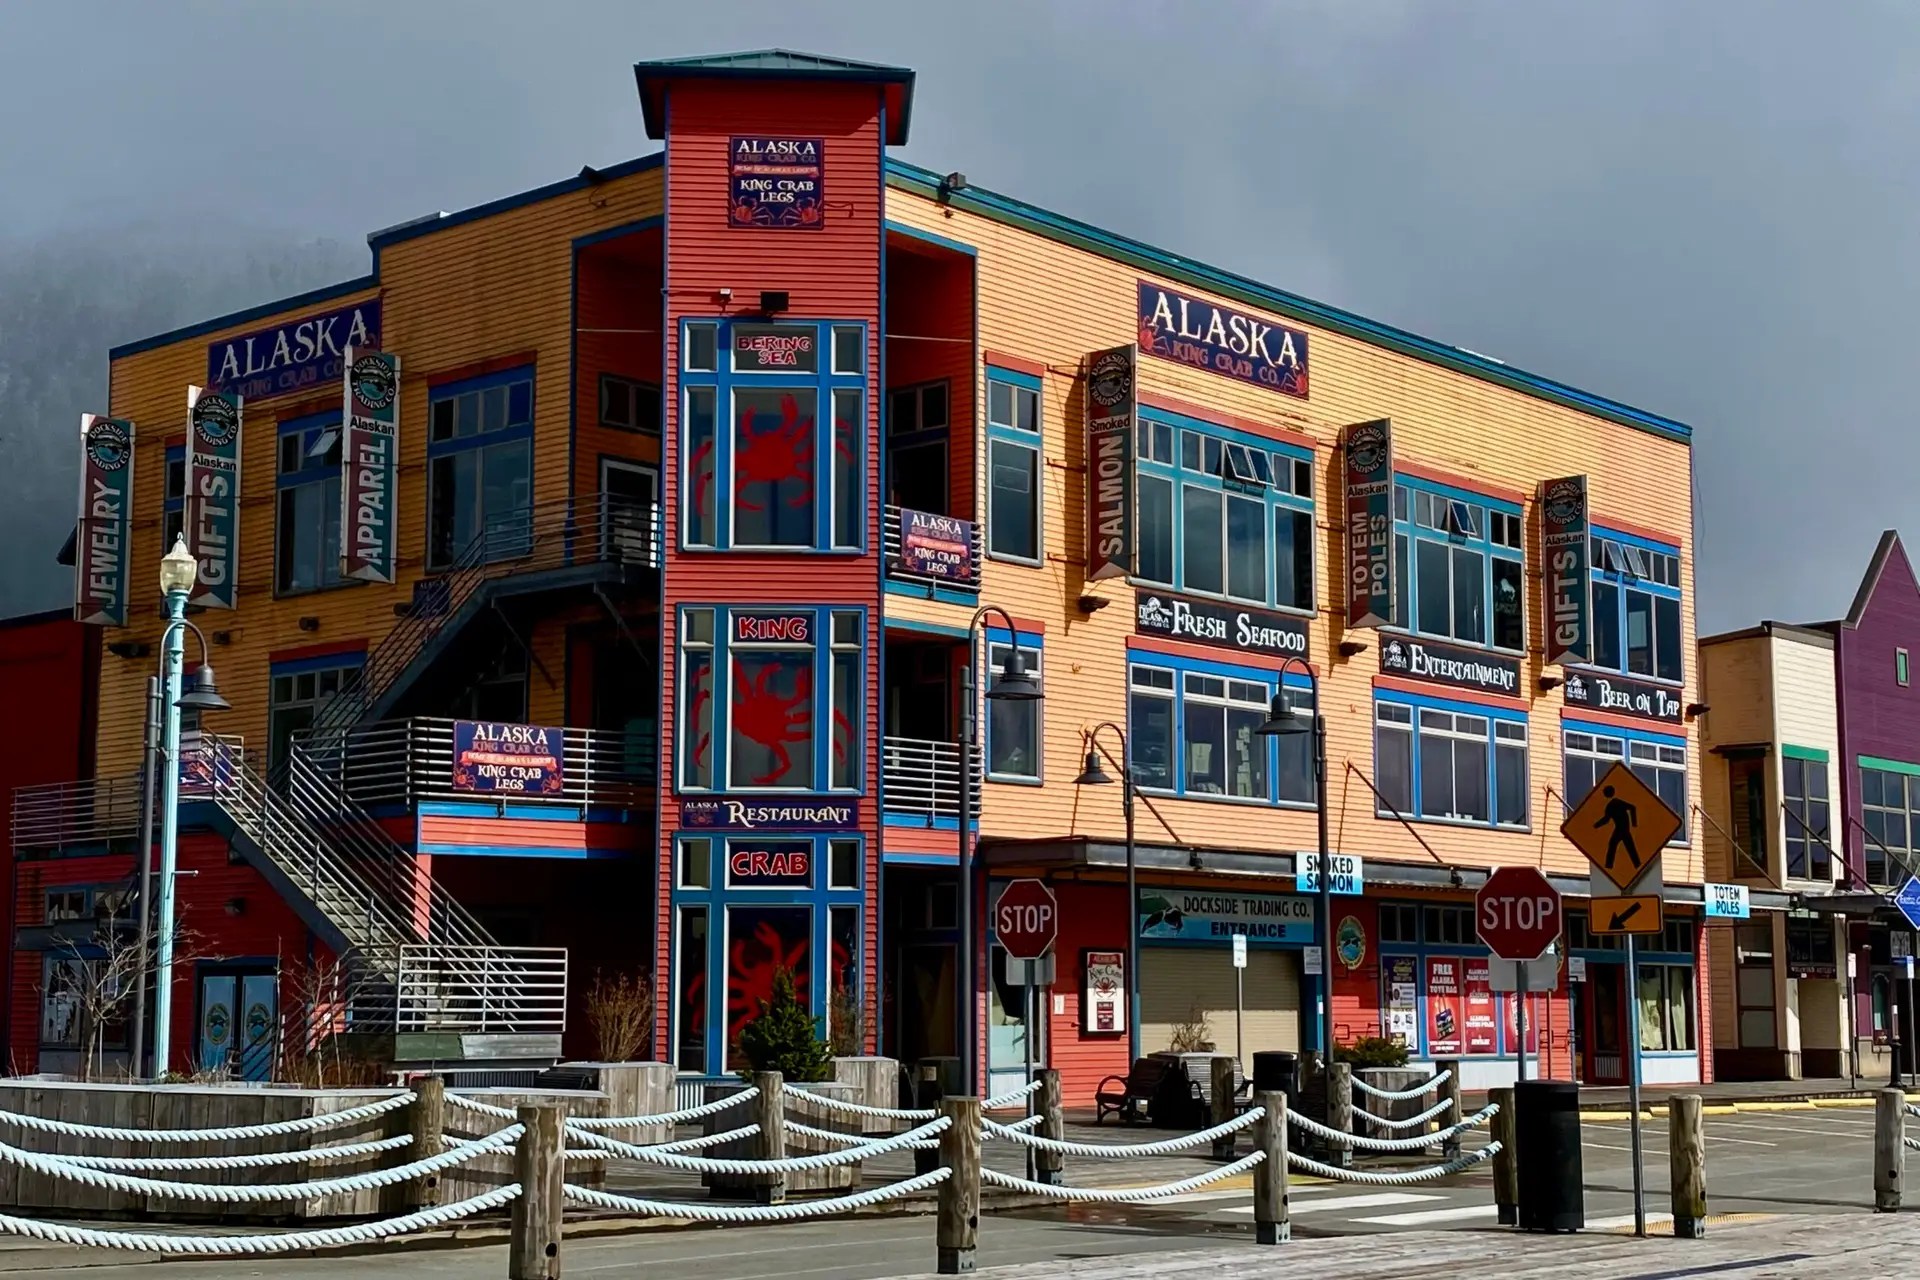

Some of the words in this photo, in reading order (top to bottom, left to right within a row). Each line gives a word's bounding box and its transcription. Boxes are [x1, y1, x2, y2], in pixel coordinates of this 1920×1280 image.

[737, 140, 816, 155] ALASKA
[740, 179, 772, 191] KING
[777, 180, 814, 192] CRAB
[760, 192, 794, 203] LEGS
[1148, 291, 1300, 370] ALASKA
[214, 309, 369, 384] ALASKA
[738, 336, 812, 352] BERING
[758, 350, 797, 364] SEA
[1092, 354, 1129, 376] DOCKSIDE
[1172, 340, 1209, 365] KING
[1215, 353, 1254, 377] CRAB
[354, 357, 392, 380] DOCKSIDE
[352, 382, 386, 409] TRADING
[1090, 385, 1123, 406] TRADING
[196, 396, 236, 418] DOCKSIDE
[89, 424, 129, 444] DOCKSIDE
[194, 420, 228, 446] TRADING
[350, 416, 394, 435] Alaskan
[1090, 414, 1130, 432] Smoked
[88, 446, 121, 470] TRADING
[192, 454, 236, 471] Alaskan
[1098, 435, 1124, 558] SALMON
[1348, 483, 1388, 497] Alaskan
[357, 440, 385, 565] APPAREL
[200, 474, 228, 585] GIFTS
[912, 514, 962, 534] ALASKA
[90, 478, 120, 608] JEWELRY
[1546, 534, 1584, 546] Alaskan
[914, 546, 935, 560] KING
[937, 552, 960, 564] CRAB
[1352, 512, 1368, 602] TOTEM
[1371, 513, 1388, 596] POLES
[926, 562, 948, 574] LEGS
[1552, 550, 1580, 646] GIFTS
[738, 616, 808, 640] KING
[1171, 600, 1227, 639] FRESH
[1236, 613, 1306, 651] SEAFOOD
[1410, 644, 1516, 690] ENTERTAINMENT
[1596, 679, 1634, 711] BEER
[1656, 690, 1680, 716] TAP
[474, 724, 548, 746] ALASKA
[472, 741, 498, 753] KING
[503, 742, 531, 754] CRAB
[478, 764, 506, 778] KING
[510, 768, 542, 780] CRAB
[495, 778, 524, 790] LEGS
[722, 800, 851, 828] RESTAURANT
[731, 852, 809, 876] CRAB
[1306, 873, 1353, 892] SAMON
[1714, 886, 1740, 900] TOTEM
[1184, 896, 1238, 914] DOCKSIDE
[1244, 900, 1289, 918] TRADING
[1292, 902, 1310, 918] CO.
[1482, 896, 1554, 930] STOP
[1716, 900, 1740, 915] POLES
[1000, 905, 1052, 934] STOP
[1211, 920, 1287, 938] ENTRANCE
[1432, 976, 1455, 984] ALASKA
[1433, 964, 1454, 975] FREE
